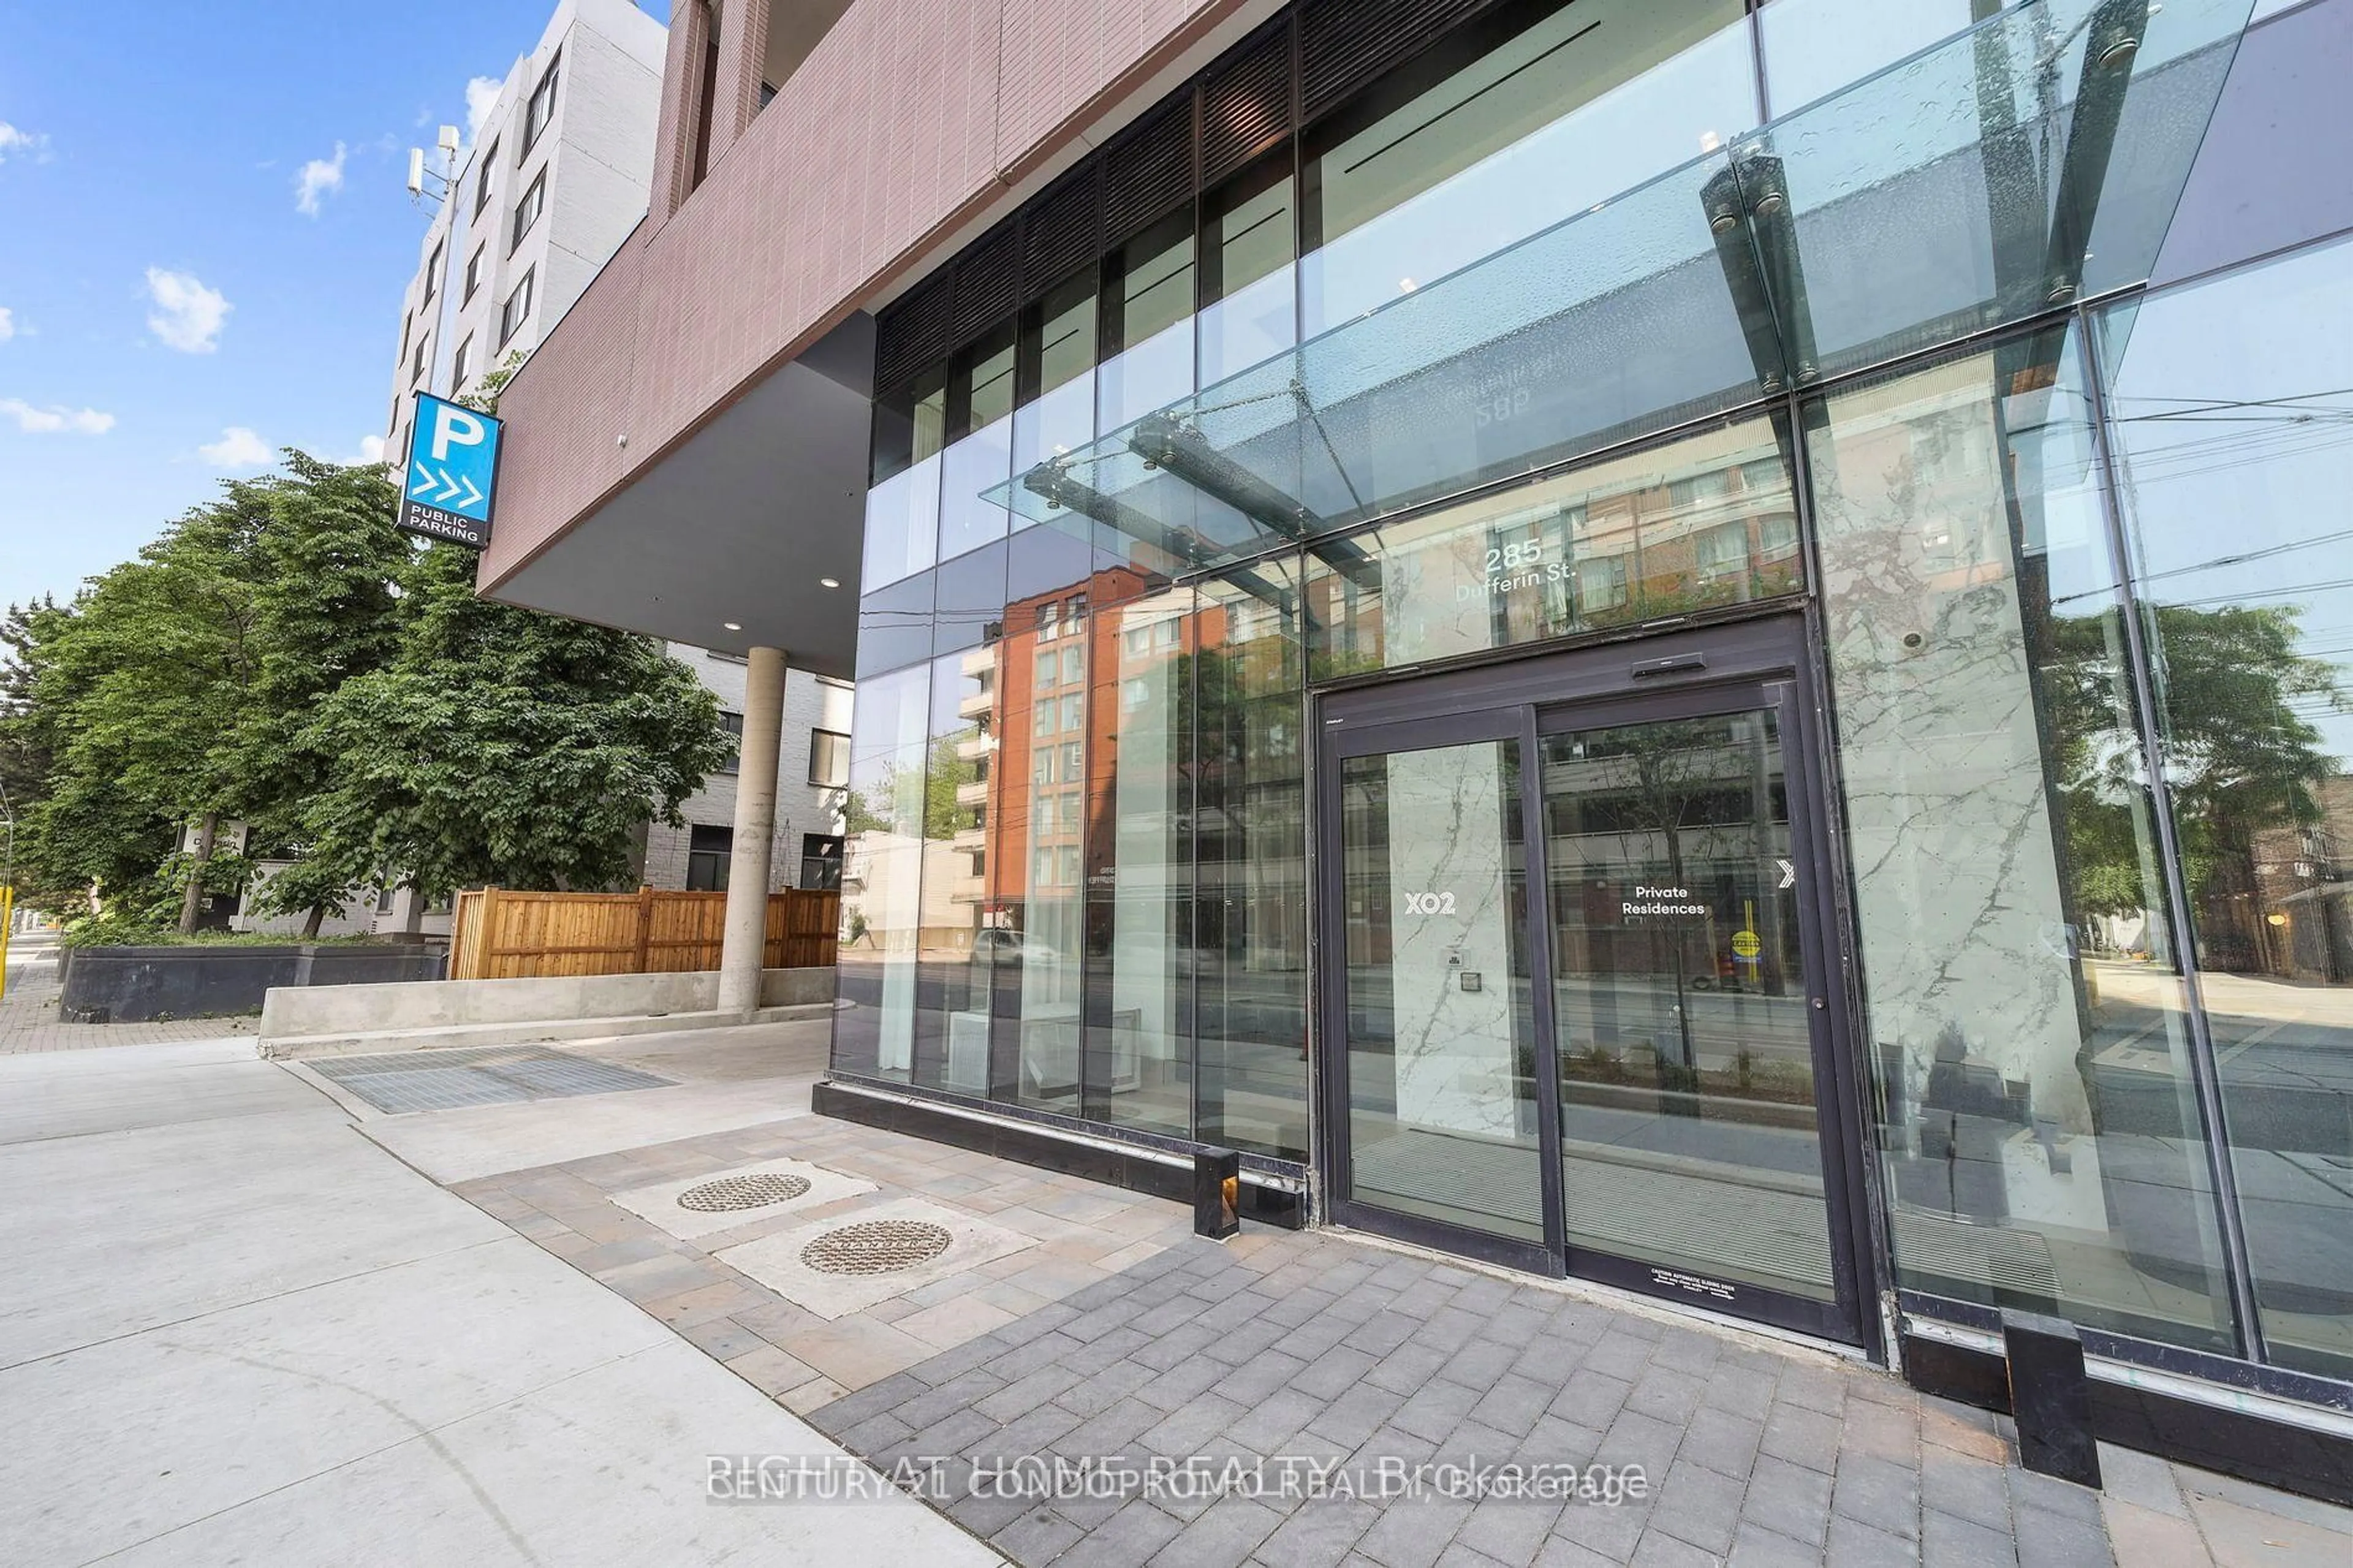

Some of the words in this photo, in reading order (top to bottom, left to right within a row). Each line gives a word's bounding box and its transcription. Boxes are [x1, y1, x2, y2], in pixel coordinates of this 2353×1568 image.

[431, 404, 485, 461] P
[409, 515, 478, 542] PARKING
[411, 504, 468, 528] PUBLIC
[1485, 537, 1542, 574] 285
[1456, 571, 1540, 602] Dufferin
[1546, 561, 1577, 582] St.
[1404, 892, 1457, 915] XO2
[1635, 886, 1688, 898] Private
[1622, 902, 1705, 915] Residences
